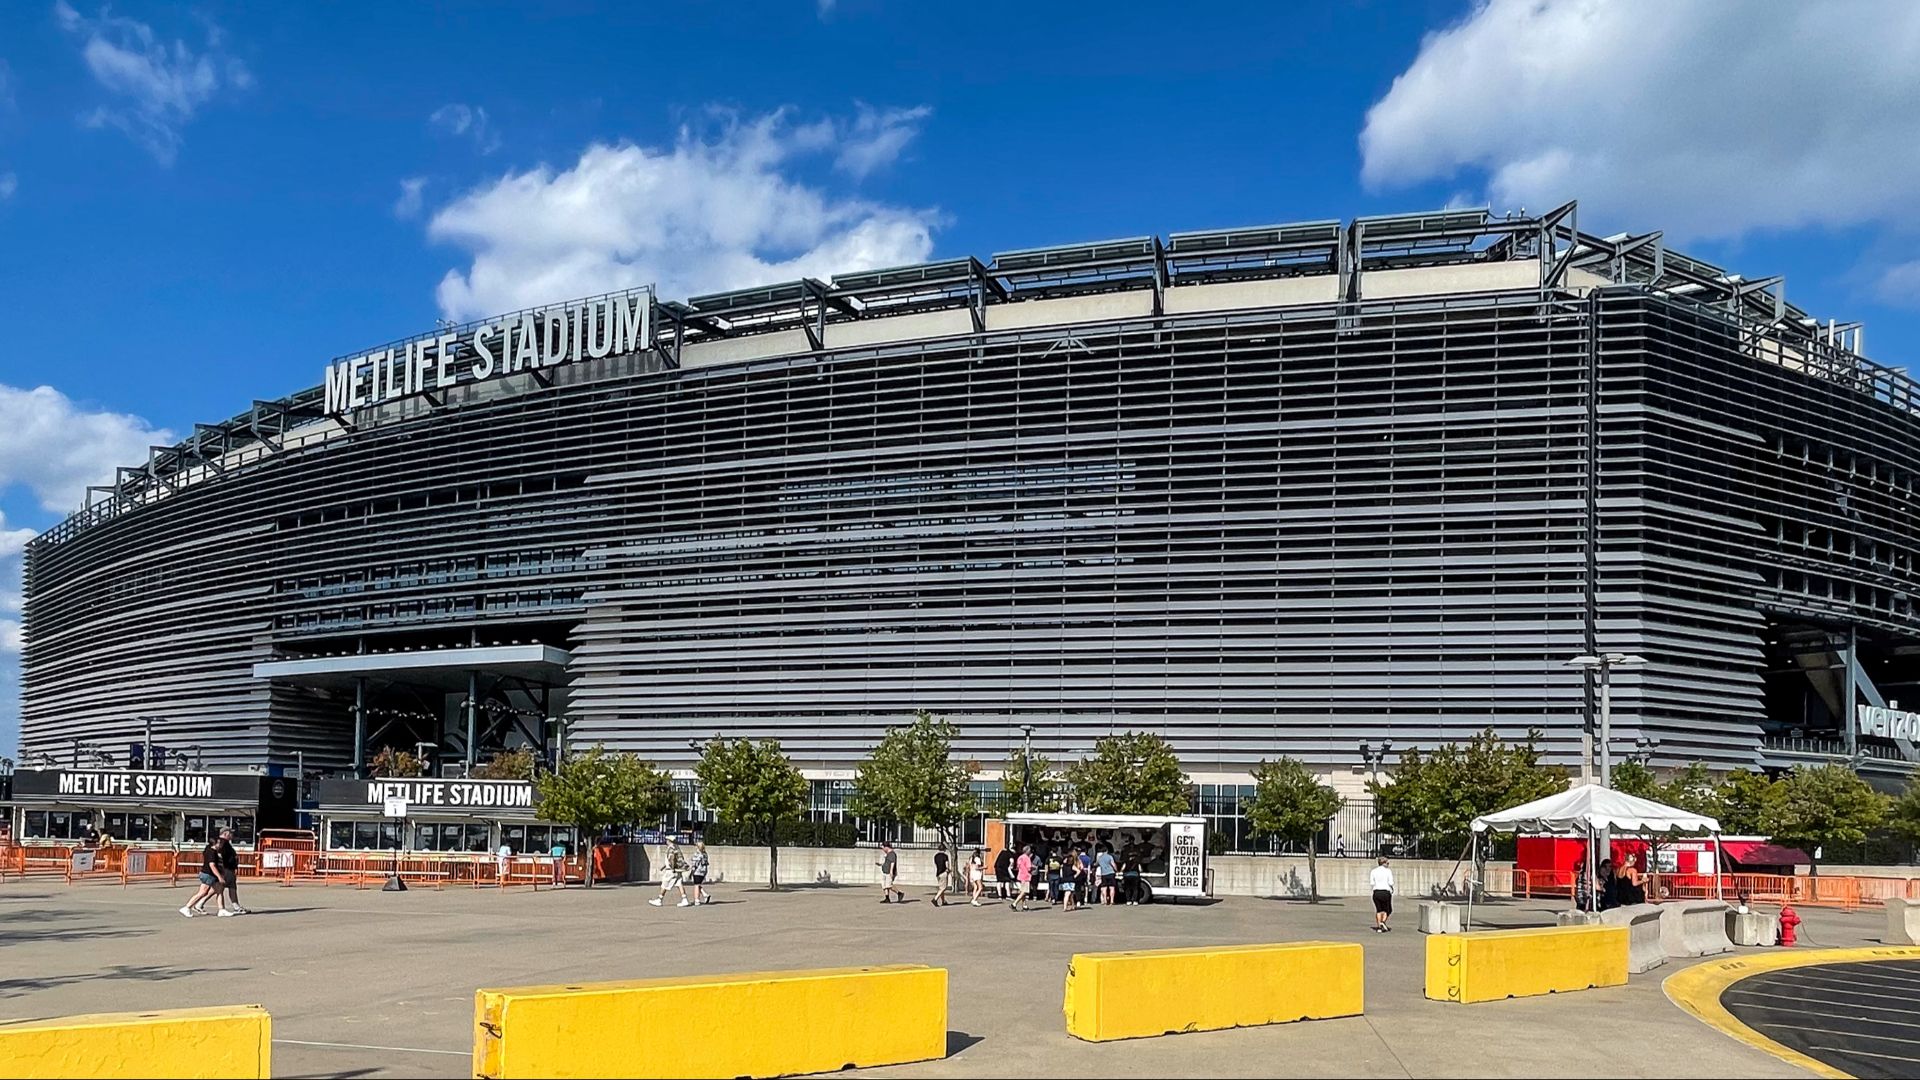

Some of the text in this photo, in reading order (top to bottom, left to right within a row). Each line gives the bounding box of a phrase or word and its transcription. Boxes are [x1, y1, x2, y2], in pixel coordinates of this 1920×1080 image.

[324, 293, 651, 415] METLIFE STADIUM
[1857, 701, 1920, 742] verizo
[59, 773, 212, 797] METLIFE STADIUM
[367, 782, 532, 807] METLIFE STADIUM
[1176, 835, 1196, 845] GET
[1175, 846, 1199, 856] YOUR
[1173, 856, 1200, 866] TEAM
[1174, 866, 1199, 876] GEAR
[1173, 877, 1199, 887] HERE
